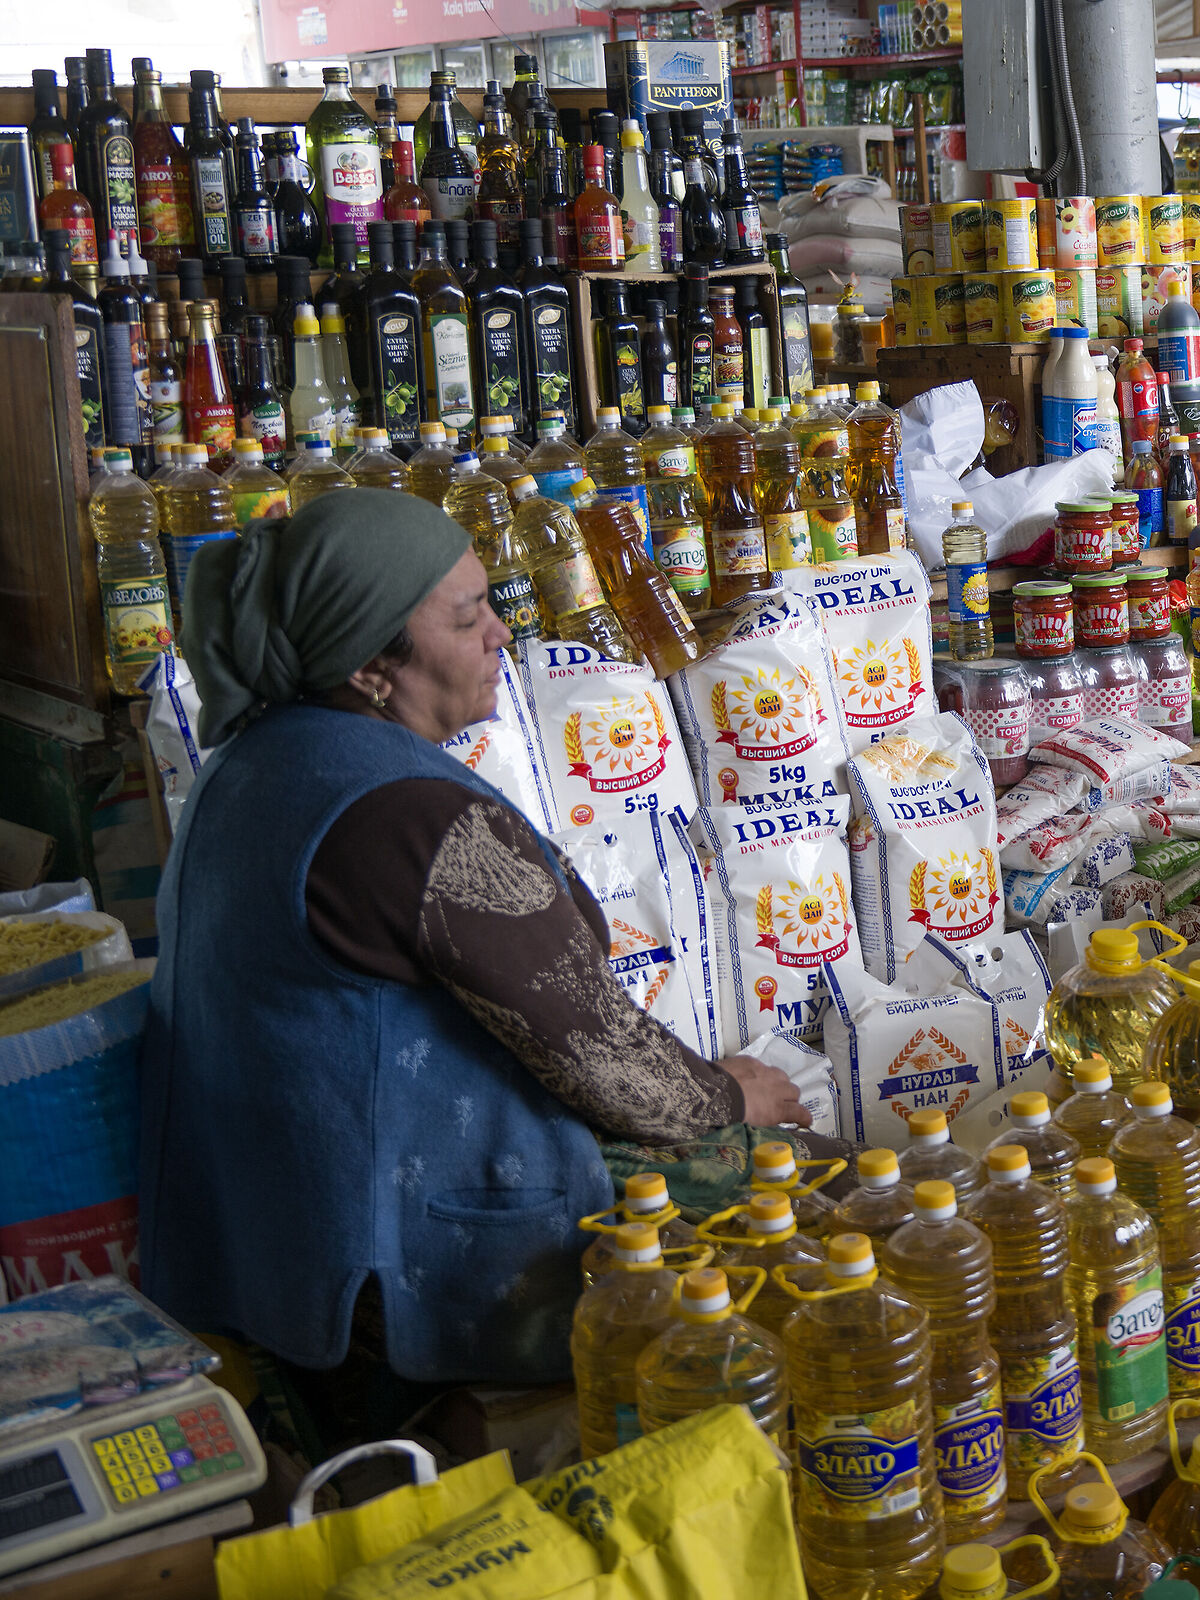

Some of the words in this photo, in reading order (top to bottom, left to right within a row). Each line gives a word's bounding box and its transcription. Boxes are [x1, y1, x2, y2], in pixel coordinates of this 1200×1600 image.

[654, 86, 718, 98] PANTHEON
[335, 171, 374, 184] Basso
[1105, 205, 1127, 217] KOLLY
[210, 235, 226, 244] OIL
[1025, 282, 1047, 294] KOLLY
[659, 457, 689, 471] Затея
[837, 526, 857, 544] Зат
[660, 545, 706, 572] Затея
[494, 580, 532, 600] Miltér
[811, 579, 914, 610] DEAL
[835, 596, 917, 617] MAXSULOTLARI
[735, 603, 800, 636] EAL
[1081, 628, 1098, 636] TOMAT
[549, 670, 575, 679] DON
[867, 665, 884, 675] АСЛ
[867, 673, 885, 682] ДАН
[759, 696, 778, 706] АСЛ
[1163, 695, 1189, 705] TOMAT
[760, 704, 781, 714] ДАН
[847, 713, 888, 725] ВЫСШИЙ
[888, 706, 909, 721] СОРТ
[1050, 714, 1081, 725] TOMAT
[613, 725, 632, 736] АСЛ
[999, 725, 1026, 737] TOMAT
[1098, 722, 1133, 741] СОЛЬ
[615, 733, 635, 744] ДАН
[741, 744, 788, 758] ВЫСШИЙ
[788, 735, 813, 751] СОРТ
[596, 772, 641, 790] ВЫСШИЙ
[641, 762, 662, 780] СОРТ
[769, 764, 806, 784] 5kg
[624, 792, 657, 814] 5kg
[891, 787, 980, 821] IDEAL
[915, 804, 985, 829] MAXSULOTLARI
[733, 809, 842, 843] IDEAL
[740, 843, 765, 855] DON
[952, 878, 969, 887] АСЛ
[953, 885, 970, 894] ДАН
[803, 900, 821, 911] АСЛ
[803, 909, 822, 919] ДАН
[972, 918, 991, 935] СОРТ
[781, 953, 824, 965] ВЫСШИЙ
[826, 942, 848, 960] СОРТ
[886, 1000, 931, 1016] БИДАЙ
[902, 1071, 957, 1091] НУРЛЫ
[914, 1093, 948, 1108] НАН
[3, 1240, 141, 1296] МАК
[1108, 1300, 1164, 1337] Затея
[953, 1426, 991, 1441] МАСЛО
[933, 1424, 1002, 1470] ЗЛАТО
[814, 1451, 896, 1475] ЗЛАТО
[427, 1539, 531, 1588] МУКА
